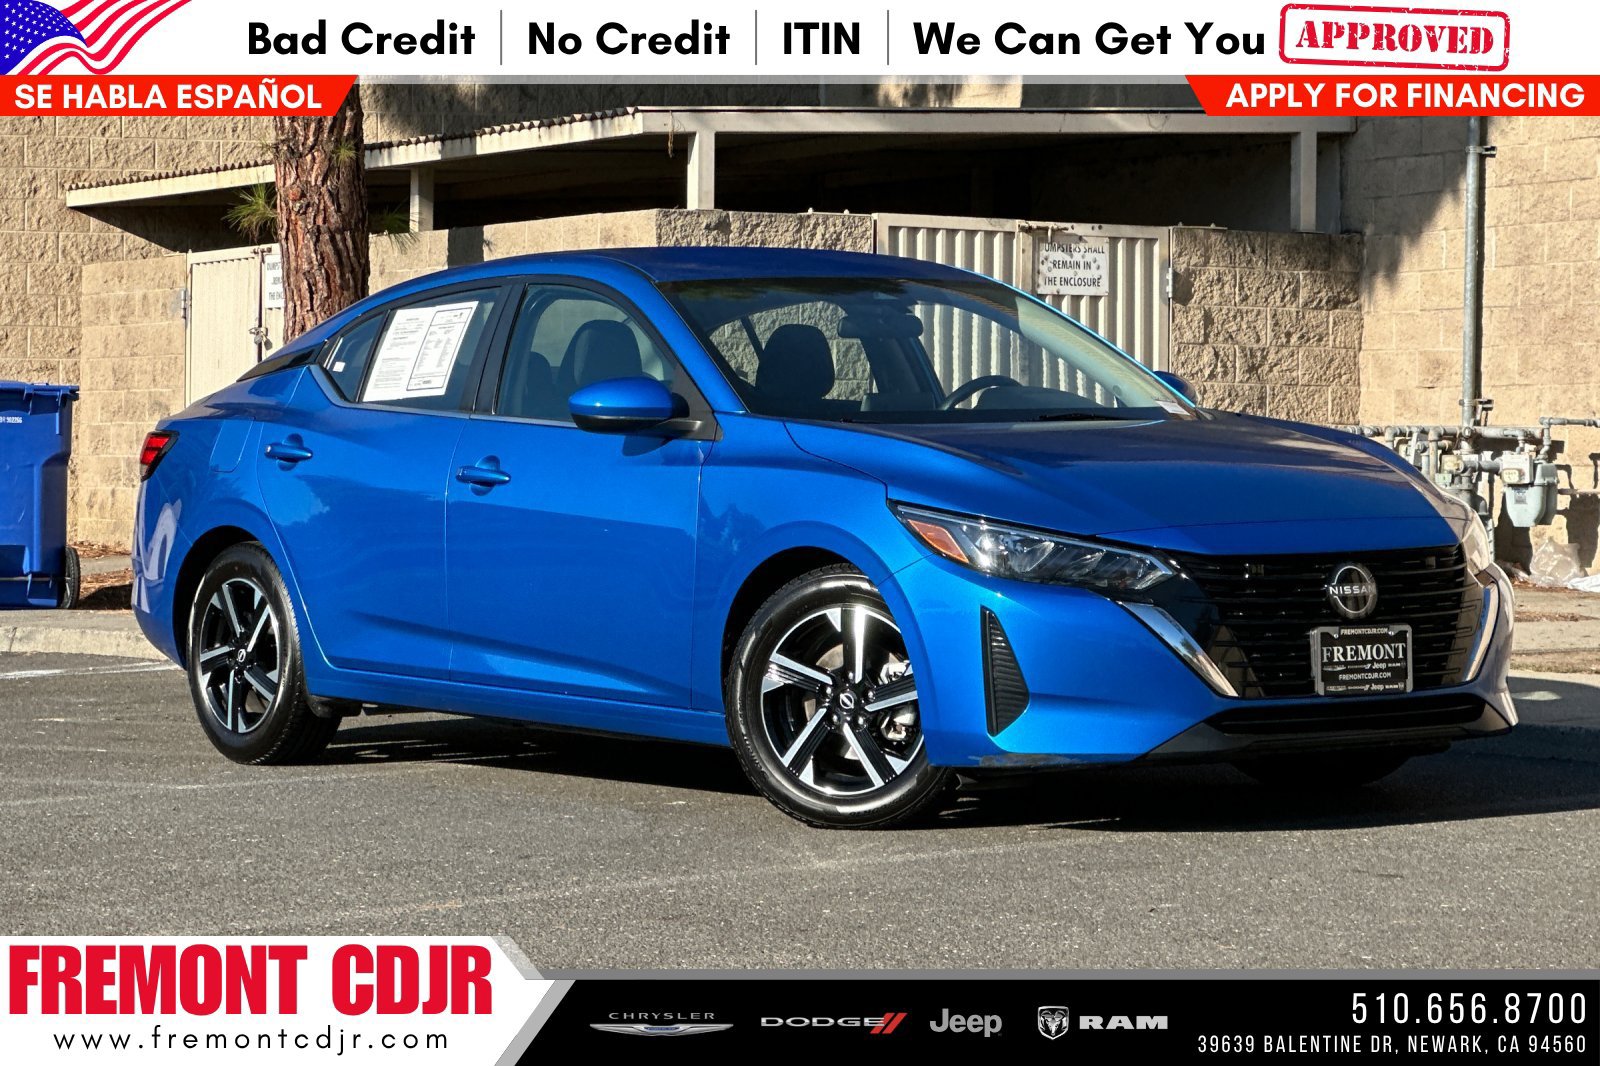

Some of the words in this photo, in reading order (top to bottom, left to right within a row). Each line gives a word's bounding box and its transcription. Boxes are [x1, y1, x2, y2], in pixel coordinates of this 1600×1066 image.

[1052, 260, 1080, 270] REMAIN
[1083, 260, 1092, 270] IN
[1044, 276, 1057, 286] THE
[1060, 277, 1101, 287] ENCLOSURE
[1329, 585, 1376, 595] NISSAN
[1322, 643, 1406, 662] FREMONT
[1372, 661, 1387, 670] Jeep
[1339, 672, 1391, 680] FREMONTCDJR.COM
